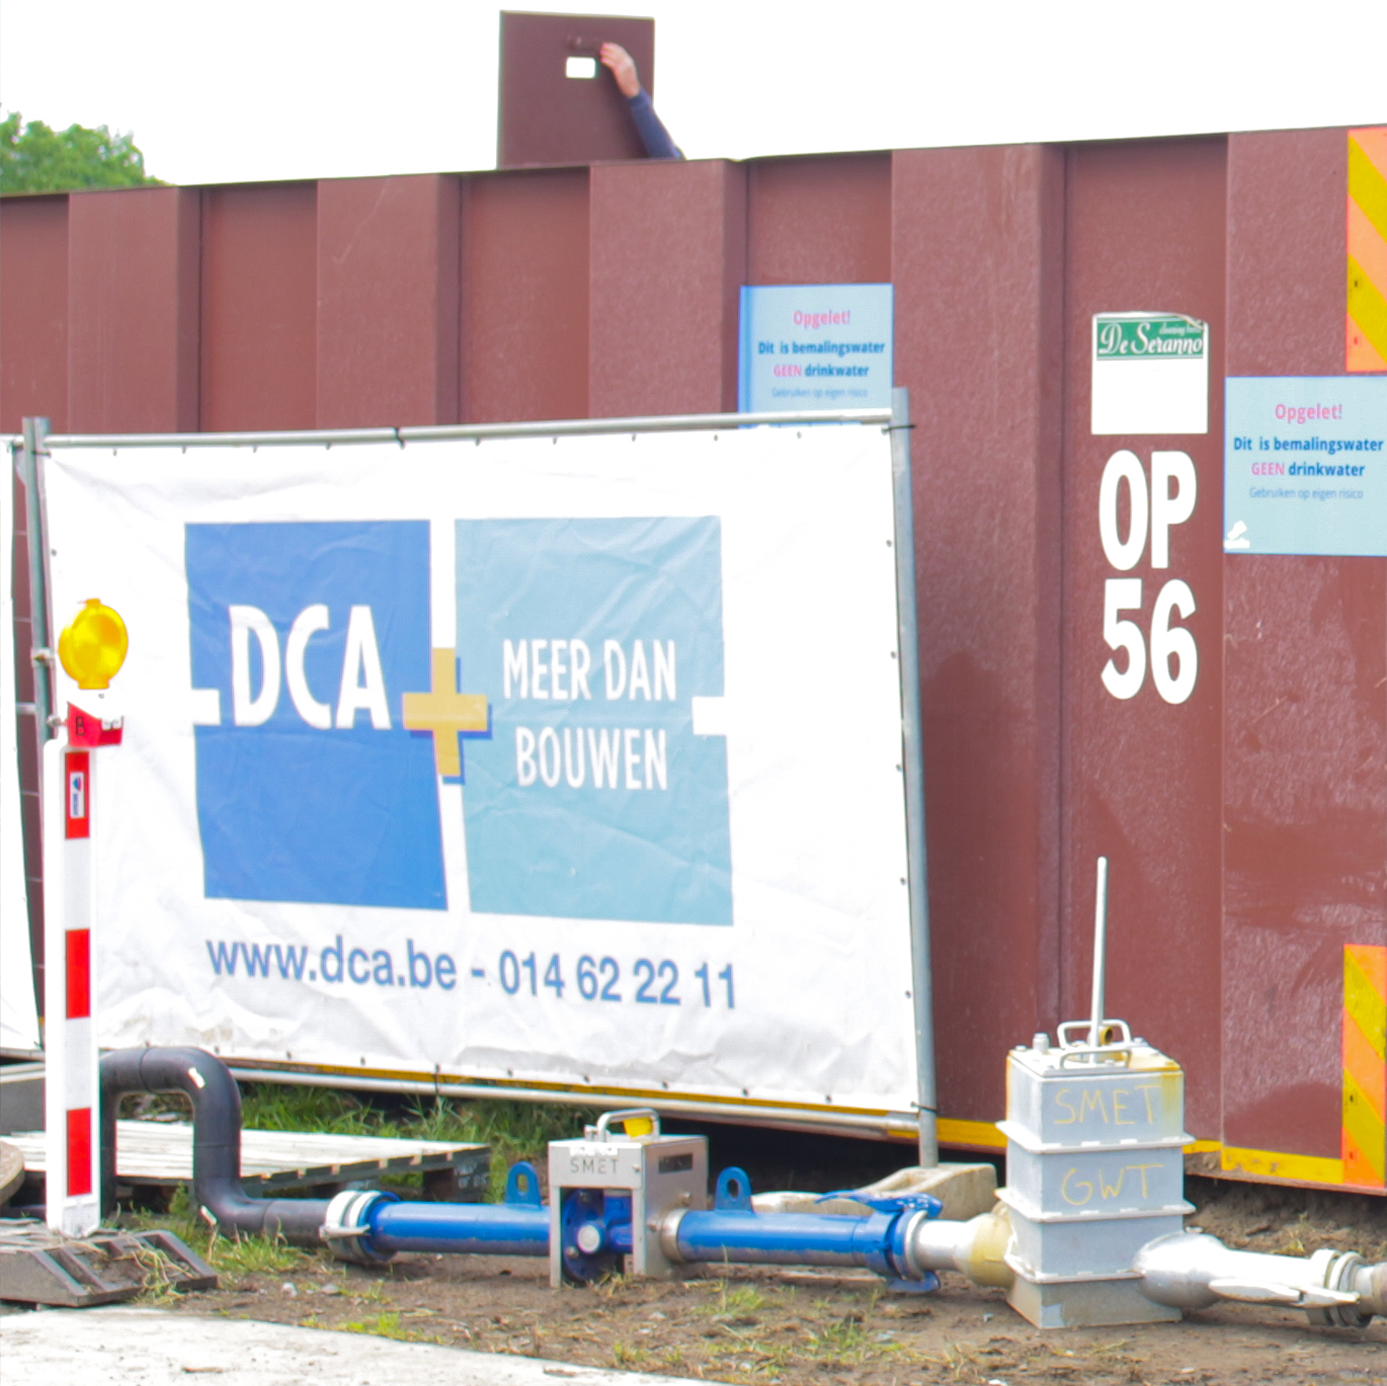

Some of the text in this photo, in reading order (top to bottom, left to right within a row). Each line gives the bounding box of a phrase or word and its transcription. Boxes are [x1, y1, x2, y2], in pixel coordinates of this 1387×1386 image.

[793, 310, 850, 329] Opgelet!
[758, 340, 885, 357] Dit is bemalingswater
[1098, 321, 1203, 355] De Seranno
[773, 364, 870, 377] GEEN drinkwater
[1275, 403, 1343, 424] Opgelet!
[1233, 436, 1384, 455] Dit is bemalingswater
[1251, 462, 1365, 476] GEEN drinkwater
[1099, 449, 1197, 571] OP
[1249, 487, 1363, 501] Gebruiken op eigen risico
[1101, 577, 1198, 704] 56
[228, 603, 392, 730] DCA
[503, 639, 676, 701] MEER DAN
[515, 726, 668, 790] BOUWEN
[206, 934, 456, 990] www.dca.be
[500, 949, 565, 998] 014
[577, 954, 622, 1001] 62
[633, 958, 681, 1005] 22
[695, 961, 735, 1009] 11
[1054, 1084, 1162, 1125] SMET
[569, 1157, 618, 1174] SMET
[1062, 1164, 1164, 1206] GWT
